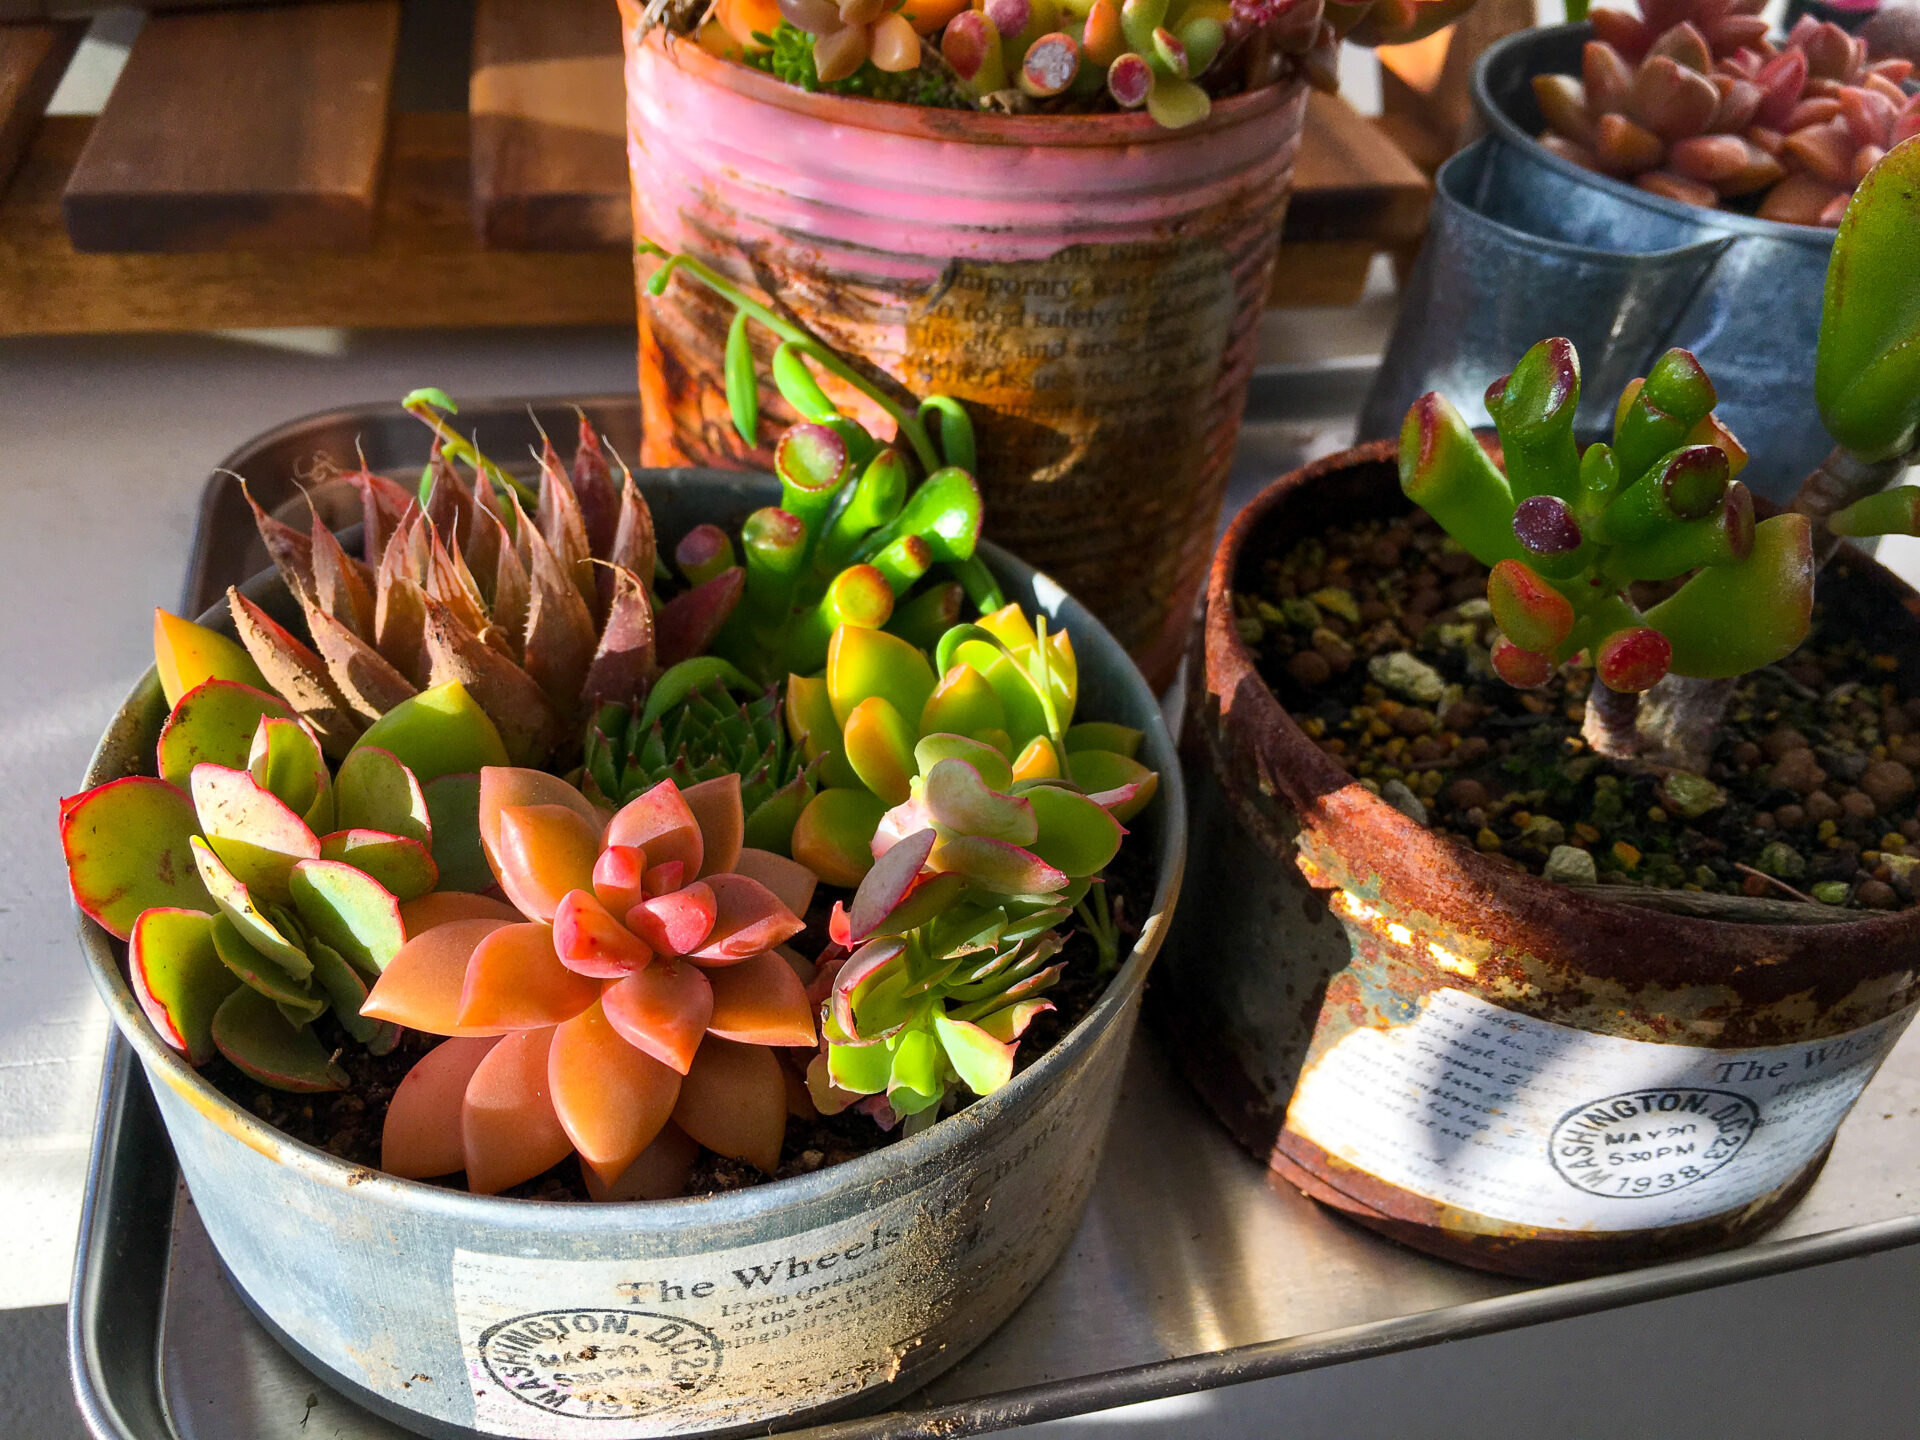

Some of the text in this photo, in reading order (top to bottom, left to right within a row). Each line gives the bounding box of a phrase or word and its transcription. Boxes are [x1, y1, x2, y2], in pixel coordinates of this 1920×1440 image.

[1715, 1056, 1789, 1084] The
[1605, 1130, 1661, 1146] MAY
[1616, 1165, 1701, 1193] 1938
[617, 1280, 716, 1305] The
[732, 1225, 899, 1288] Wheels
[730, 1316, 755, 1332] of
[761, 1305, 798, 1325] the
[803, 1296, 838, 1314] sex
[745, 1295, 788, 1315] you
